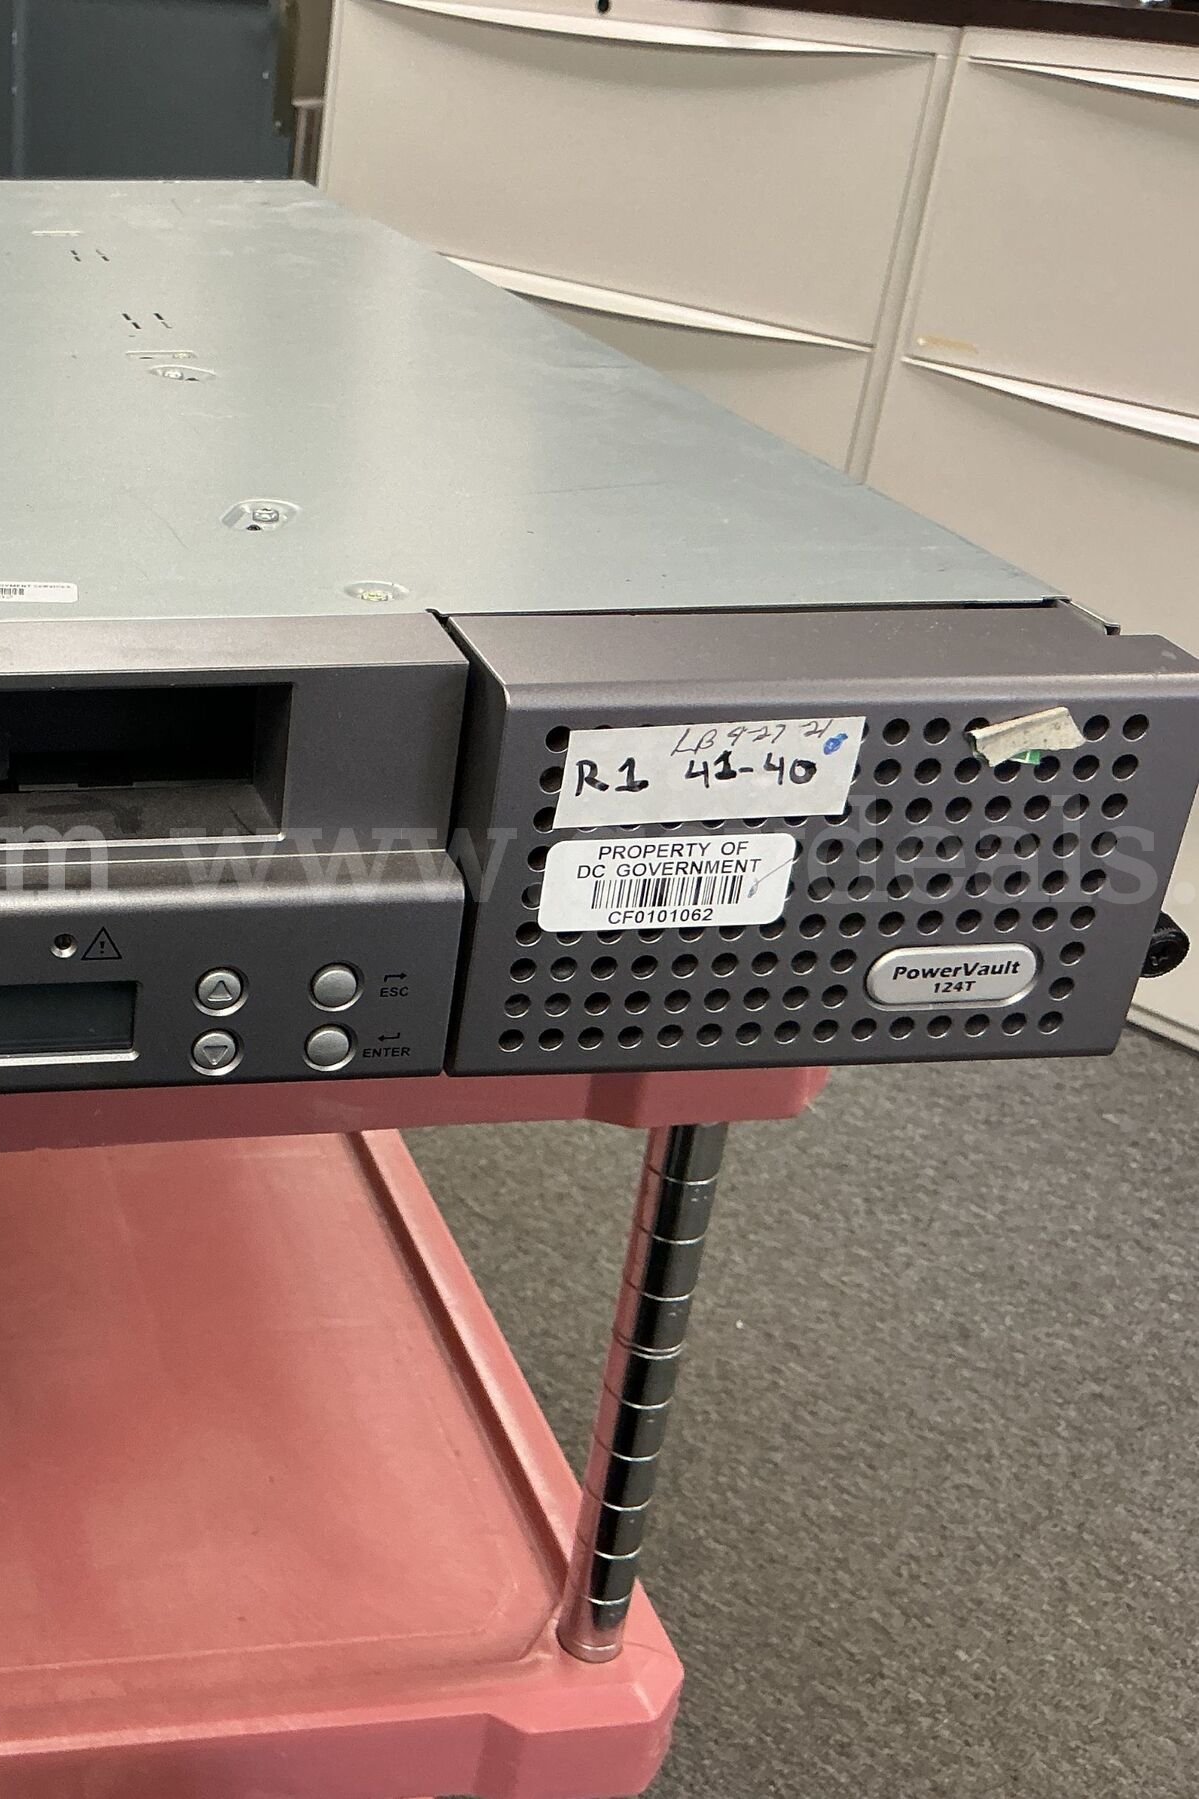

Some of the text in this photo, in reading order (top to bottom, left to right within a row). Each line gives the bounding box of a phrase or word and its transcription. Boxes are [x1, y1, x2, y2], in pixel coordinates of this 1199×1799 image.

[598, 841, 749, 860] PROPERTY OF
[577, 859, 762, 879] DC GOVERNMENT
[608, 908, 714, 925] CF0101062
[892, 960, 1020, 981] PowerVault
[379, 986, 409, 998] ESC
[933, 981, 976, 993] 124T
[362, 1047, 411, 1058] ENTER
